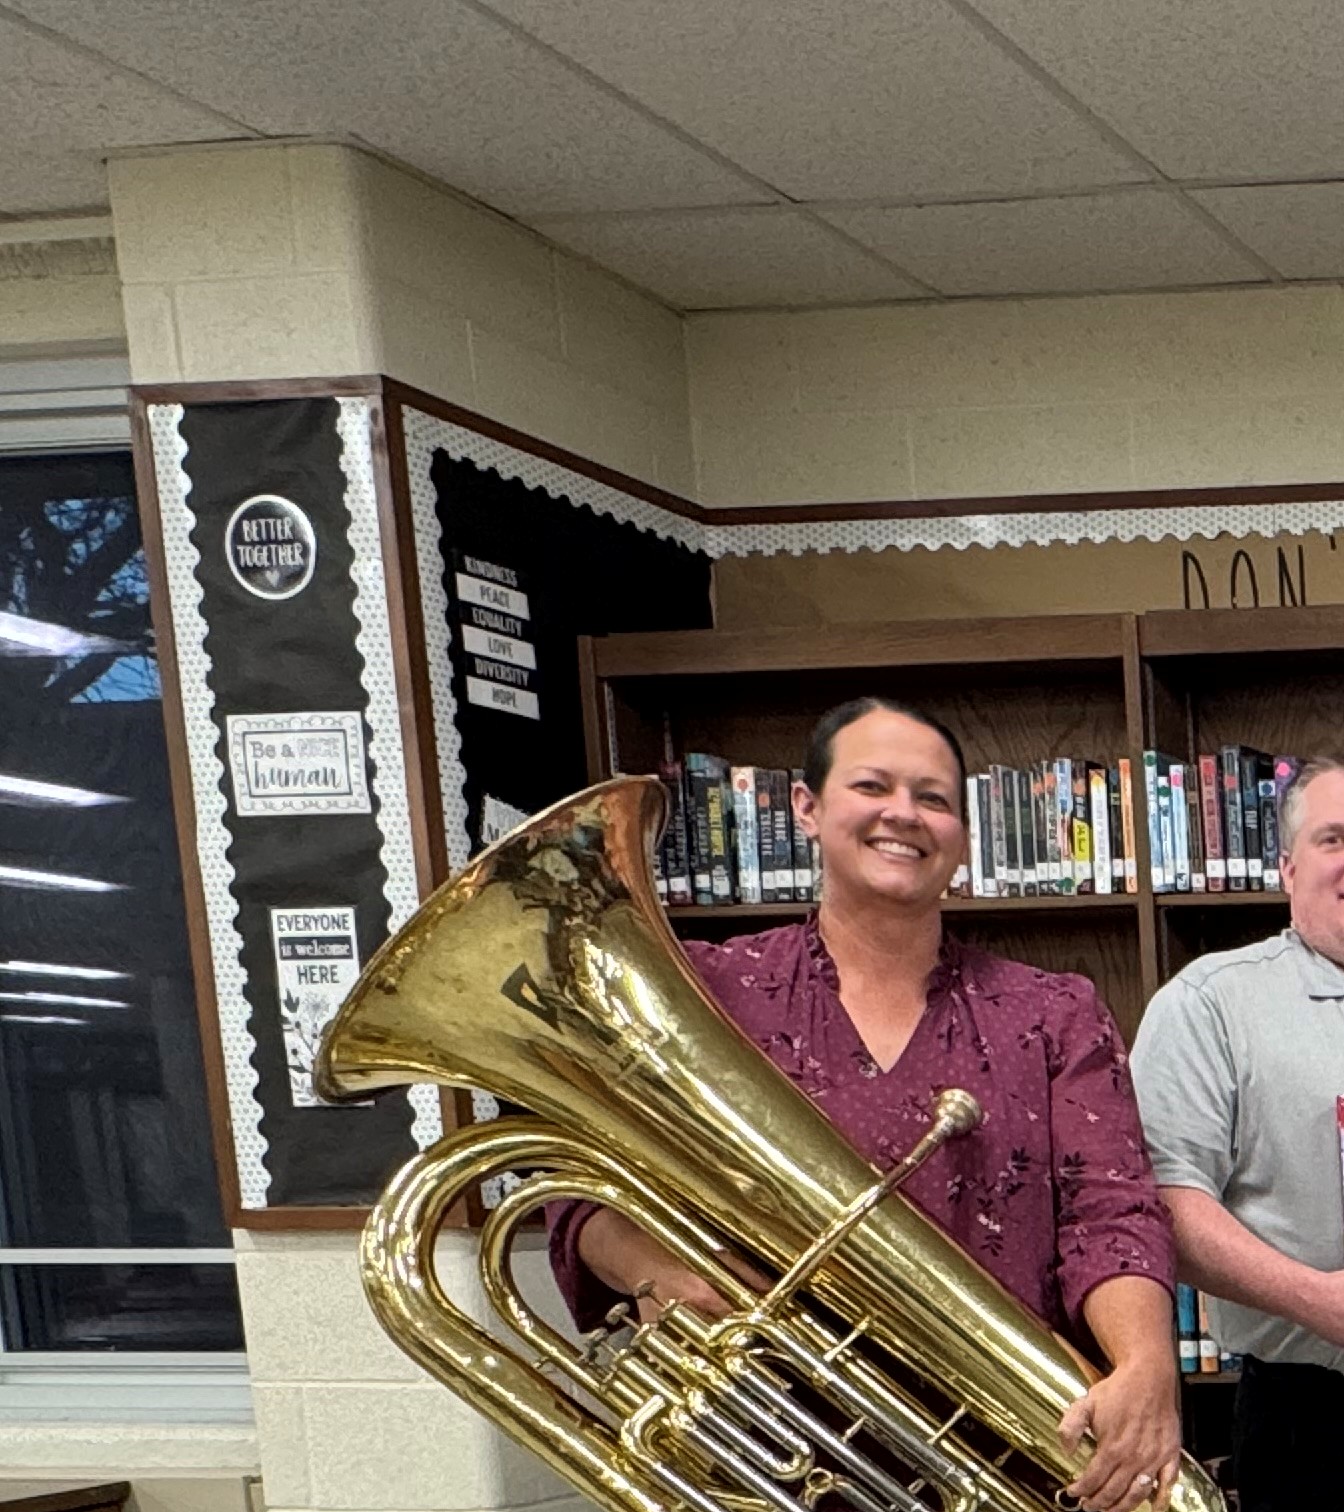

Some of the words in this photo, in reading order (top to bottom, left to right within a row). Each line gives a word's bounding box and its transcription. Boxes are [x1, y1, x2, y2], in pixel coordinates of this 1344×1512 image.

[242, 516, 294, 543] BETTER
[236, 542, 304, 568] TOGETHER
[479, 584, 510, 609] PEACE
[472, 606, 522, 637] EQUALITY
[487, 636, 514, 660] LOVE
[474, 656, 530, 688] DIVERSITY
[249, 740, 276, 759] Be
[280, 744, 296, 759] a
[254, 760, 344, 790] human
[276, 912, 351, 933] EVERYONE
[294, 938, 351, 957] welcome
[296, 964, 341, 986] HERE
